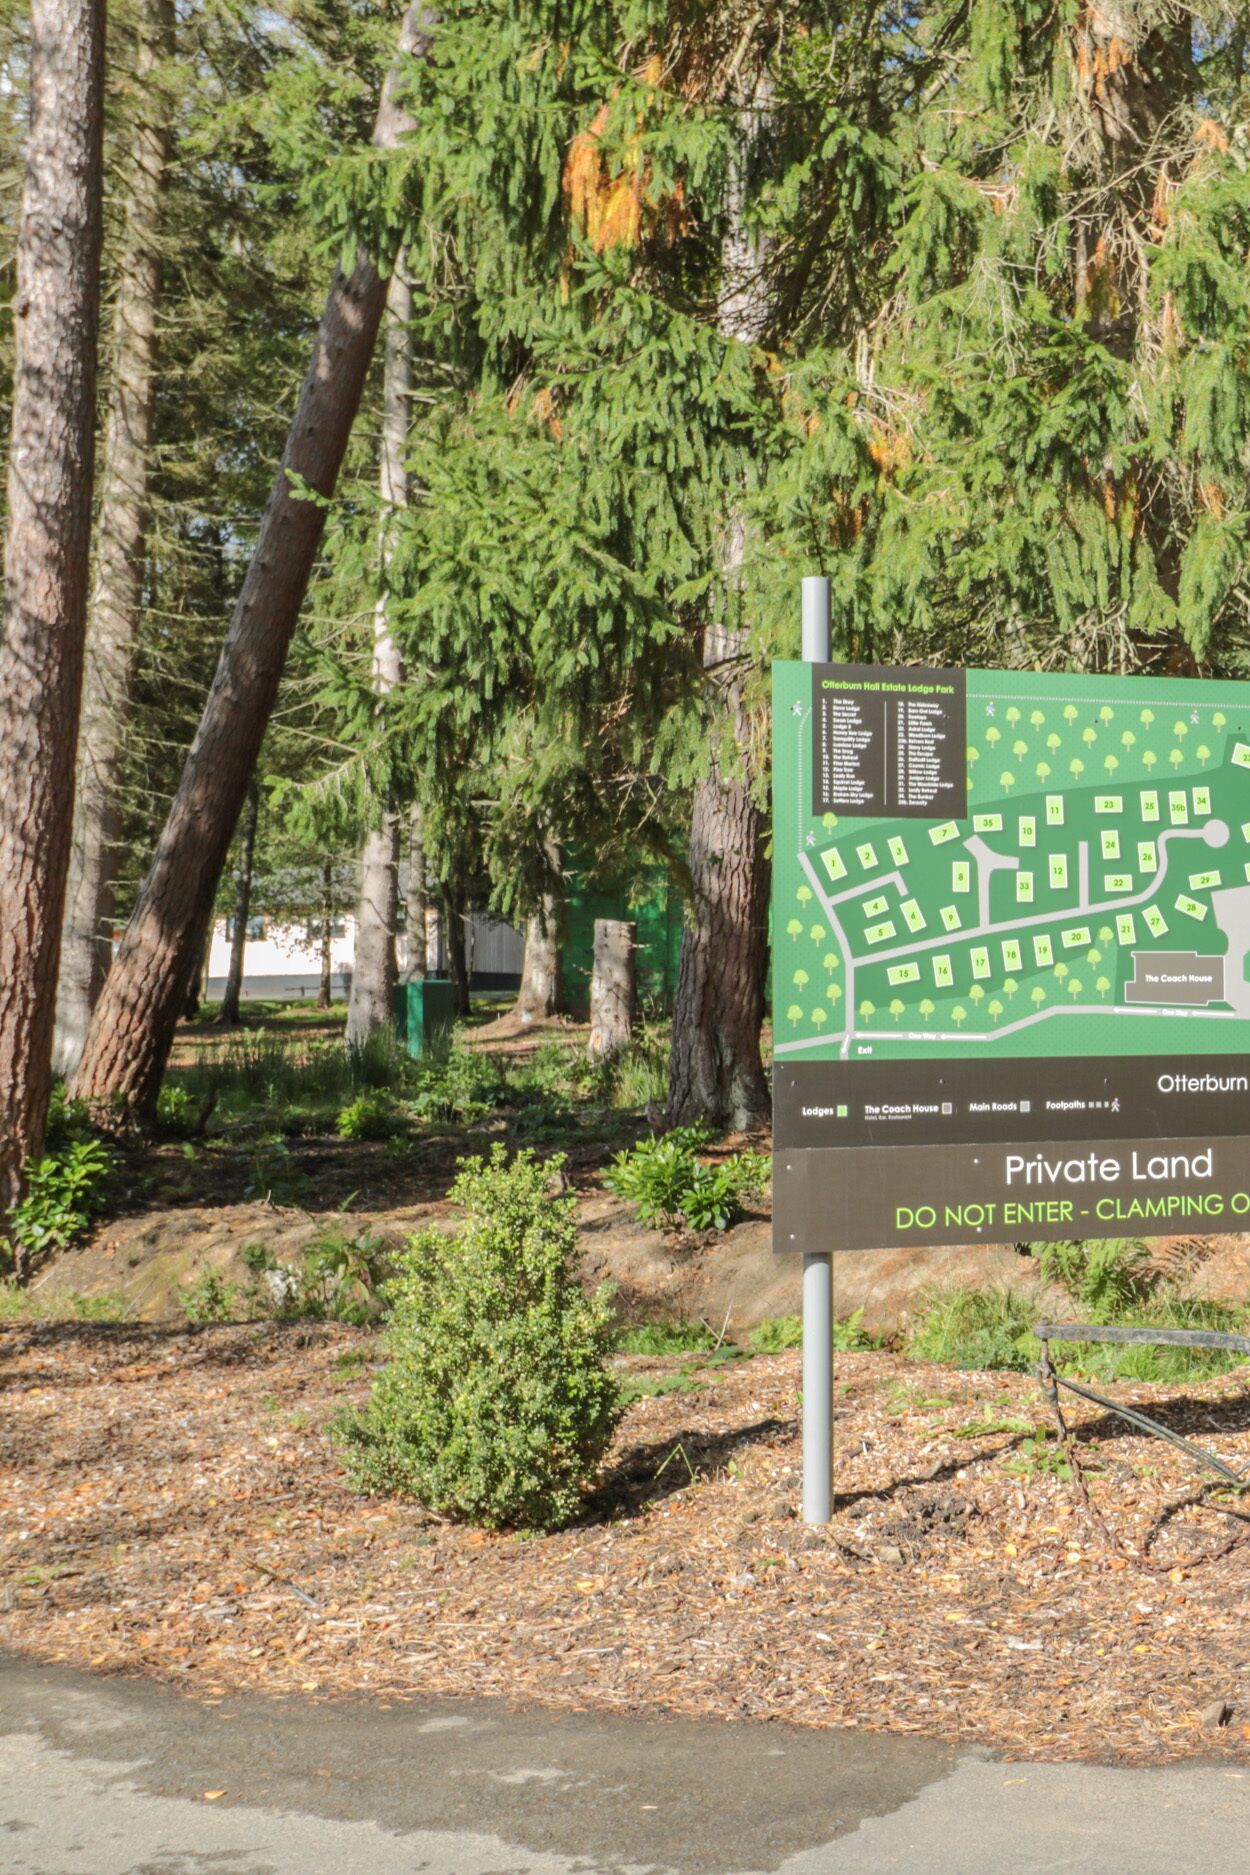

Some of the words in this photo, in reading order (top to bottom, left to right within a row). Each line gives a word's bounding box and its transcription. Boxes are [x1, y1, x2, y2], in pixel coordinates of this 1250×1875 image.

[822, 681, 862, 690] Otterburn
[864, 682, 879, 691] Hall
[882, 683, 906, 692] Estate
[908, 684, 934, 694] Lodge
[936, 685, 954, 694] Park
[1145, 802, 1154, 810] 25
[983, 819, 993, 827] 35
[865, 852, 870, 860] 2
[1200, 876, 1210, 884] 29
[1020, 882, 1029, 890] 33
[1072, 933, 1081, 941] 20
[1039, 946, 1047, 954] 19
[1007, 951, 1016, 959] 18
[976, 959, 985, 967] 17
[1160, 975, 1187, 983] Coach
[1189, 975, 1213, 983] House
[858, 1046, 872, 1054] Exit
[1158, 1074, 1248, 1092] Otterburn
[865, 1105, 880, 1114] The
[882, 1104, 911, 1114] Coach
[913, 1104, 938, 1113] House
[969, 1103, 990, 1111] Main
[992, 1102, 1017, 1111] Roads
[1046, 1101, 1085, 1110] Footpaths
[802, 1106, 834, 1117] Lodges
[1006, 1153, 1120, 1185] Private
[1132, 1148, 1213, 1181] Land
[896, 1206, 937, 1229] DO
[945, 1203, 996, 1226] NOT
[1004, 1201, 1073, 1224] ENTER
[1095, 1194, 1223, 1220] CLAMPING
